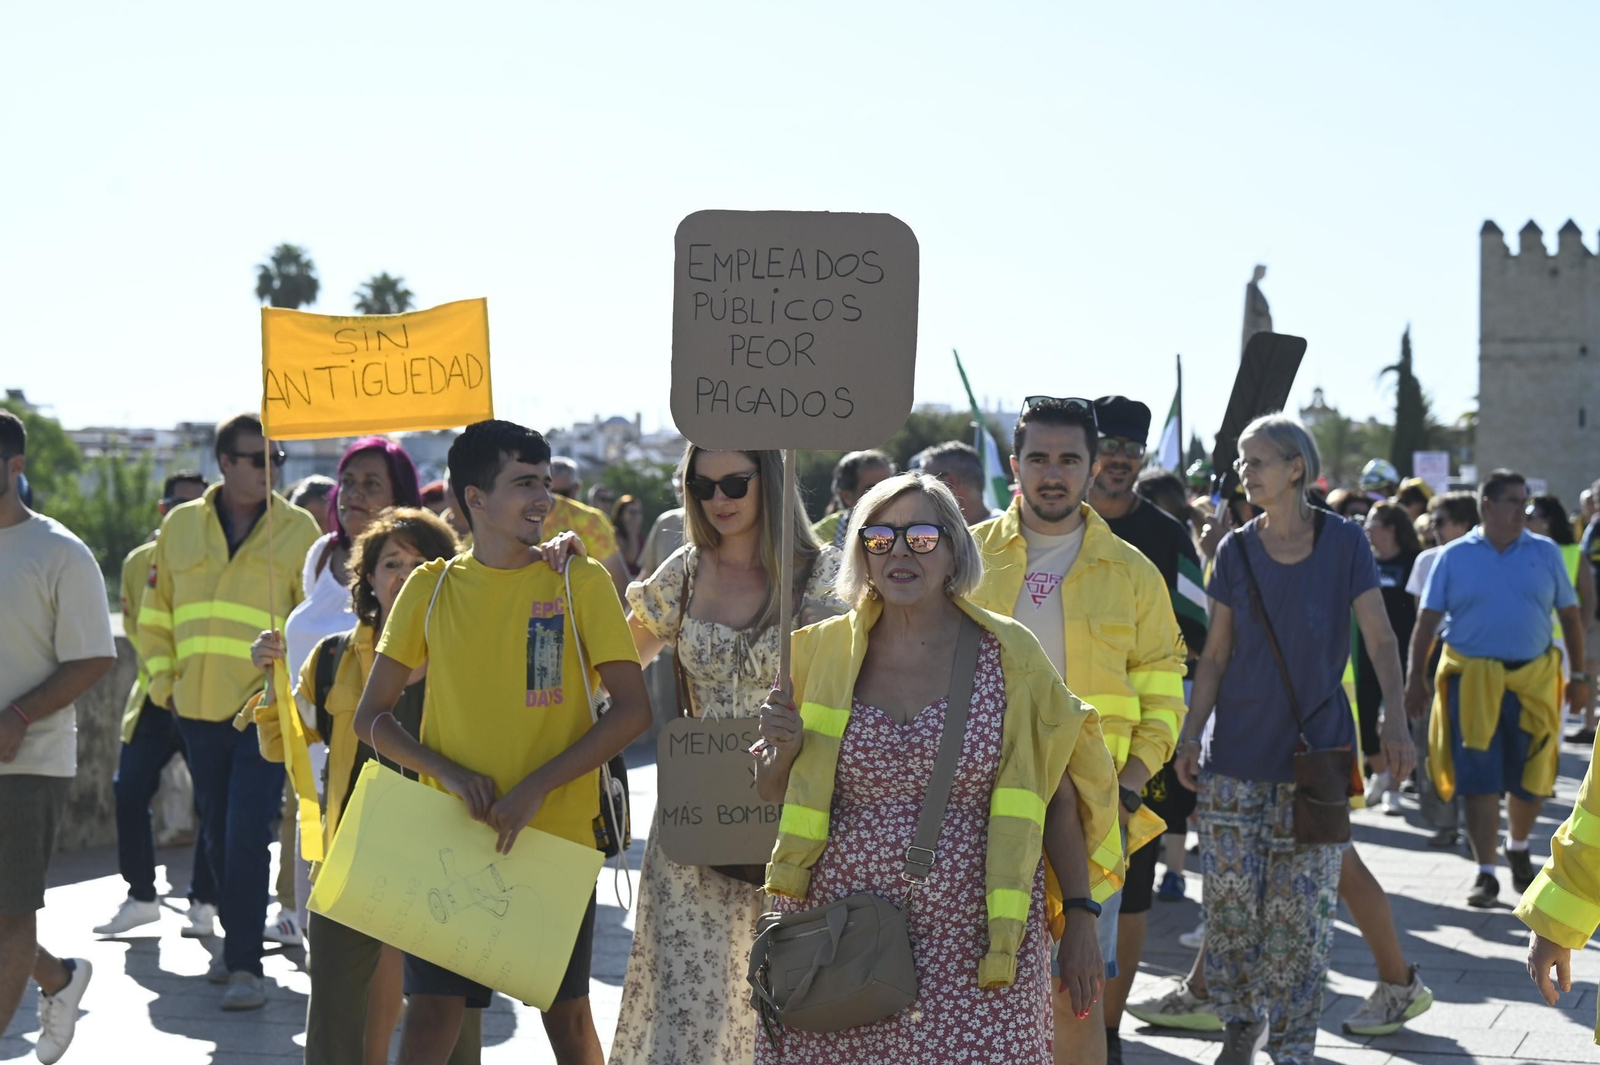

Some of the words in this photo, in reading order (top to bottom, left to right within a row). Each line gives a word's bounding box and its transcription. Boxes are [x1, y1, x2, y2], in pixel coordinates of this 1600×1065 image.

[688, 243, 884, 284] EMPLEADOS
[729, 332, 816, 369] PEOR
[696, 377, 854, 419] PAGADOS
[669, 731, 752, 758] MENOS
